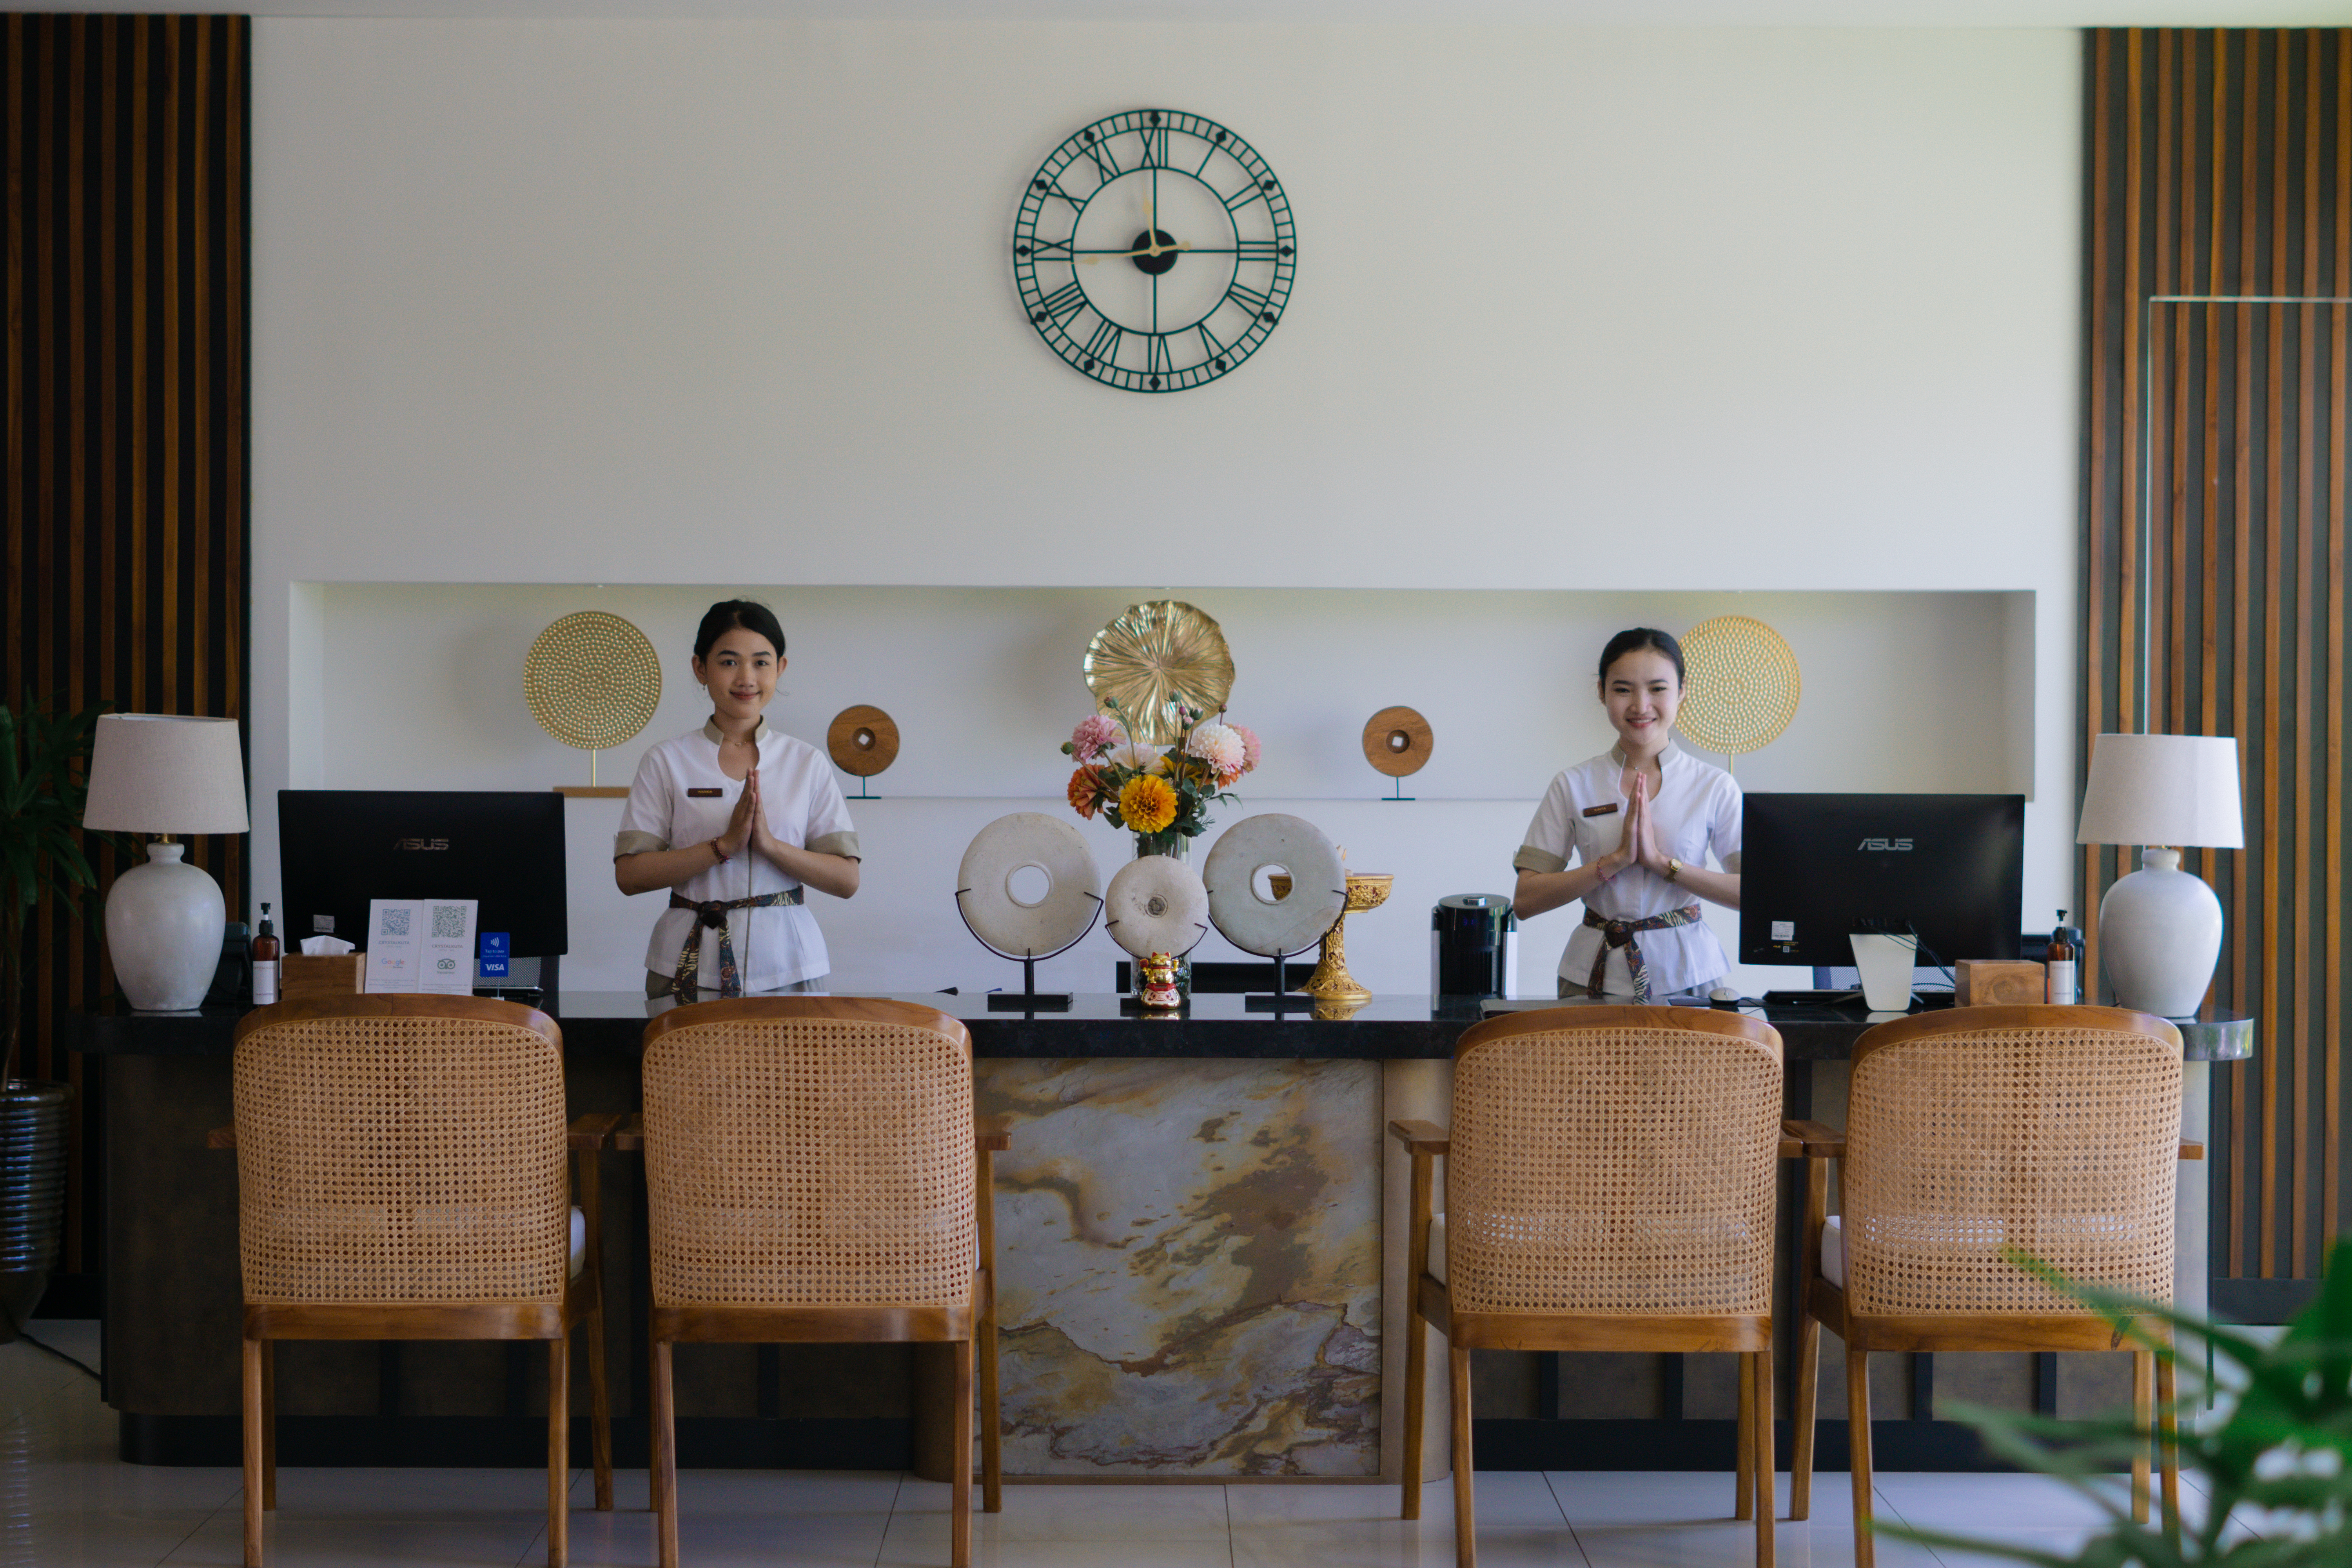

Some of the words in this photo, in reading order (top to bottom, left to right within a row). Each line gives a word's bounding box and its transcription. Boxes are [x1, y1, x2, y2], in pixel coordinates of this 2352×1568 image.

[393, 838, 449, 850] ASUS
[1857, 838, 1913, 851] ASUS
[381, 958, 405, 966] Google
